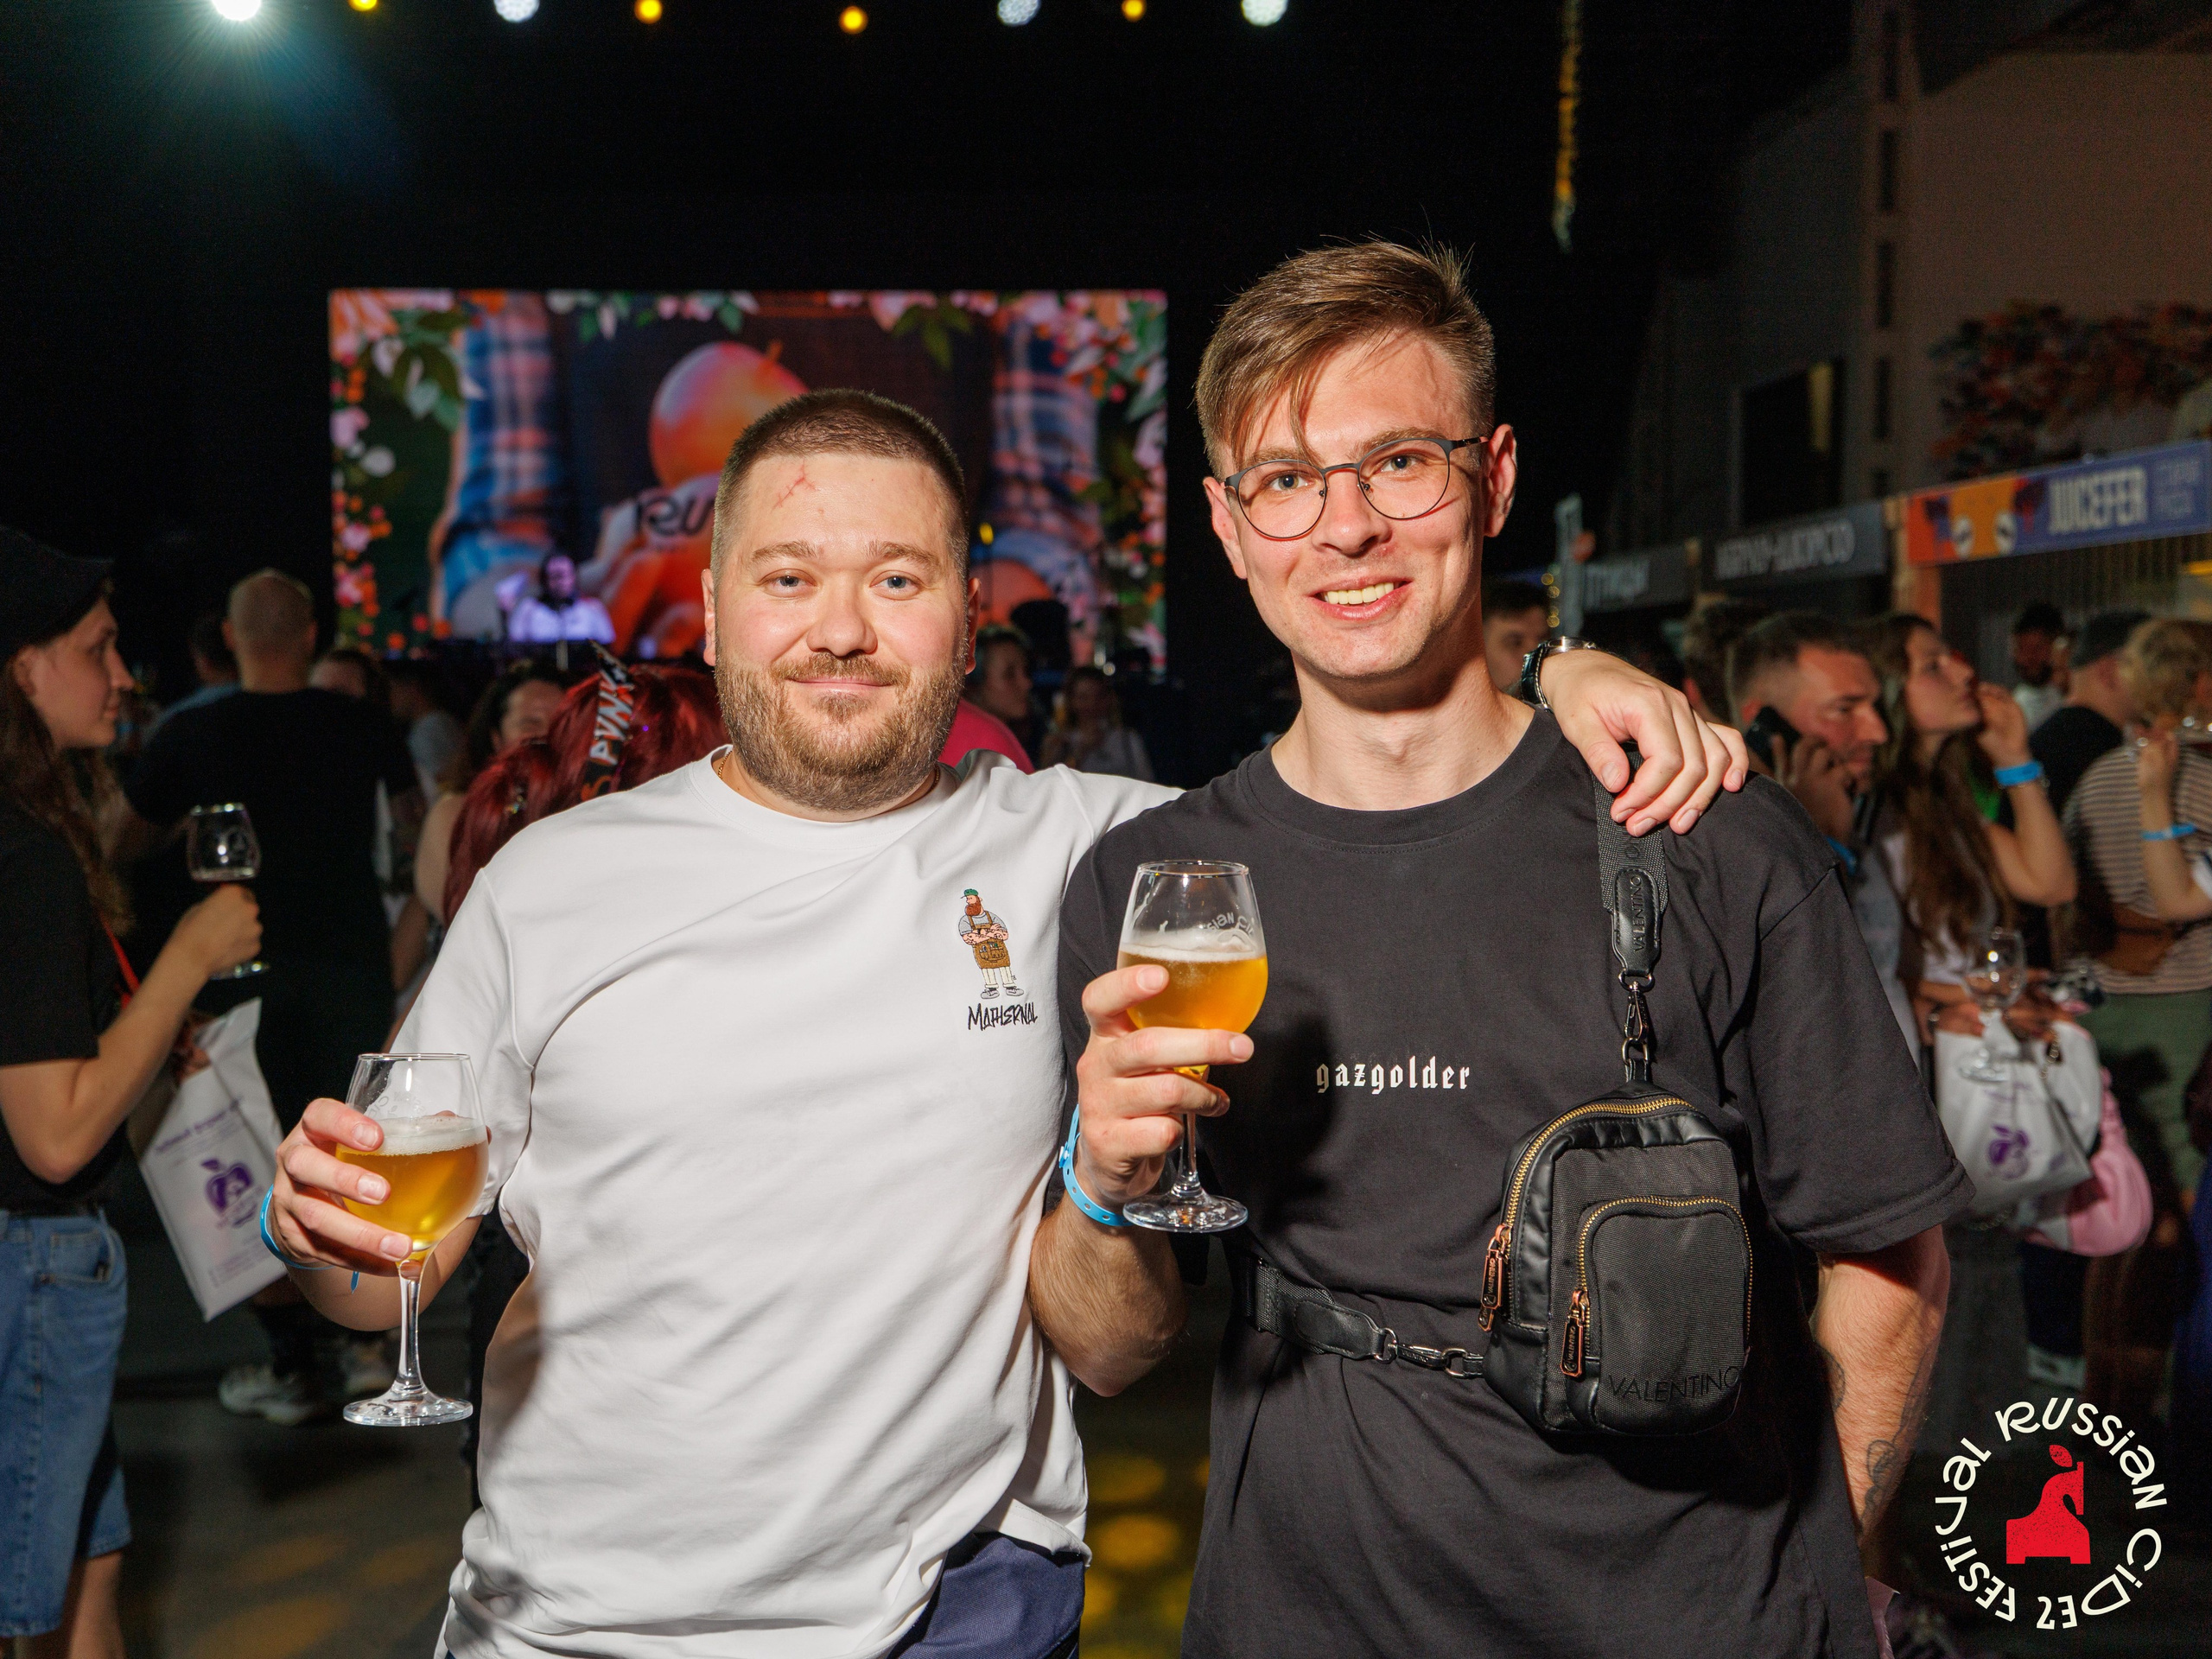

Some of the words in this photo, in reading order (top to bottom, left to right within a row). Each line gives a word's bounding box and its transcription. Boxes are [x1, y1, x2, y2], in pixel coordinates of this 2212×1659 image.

[1630, 875, 1646, 952] VALENTINO
[1316, 1055, 1470, 1095] gazgolder
[1607, 1365, 1740, 1402] VALENTINO
